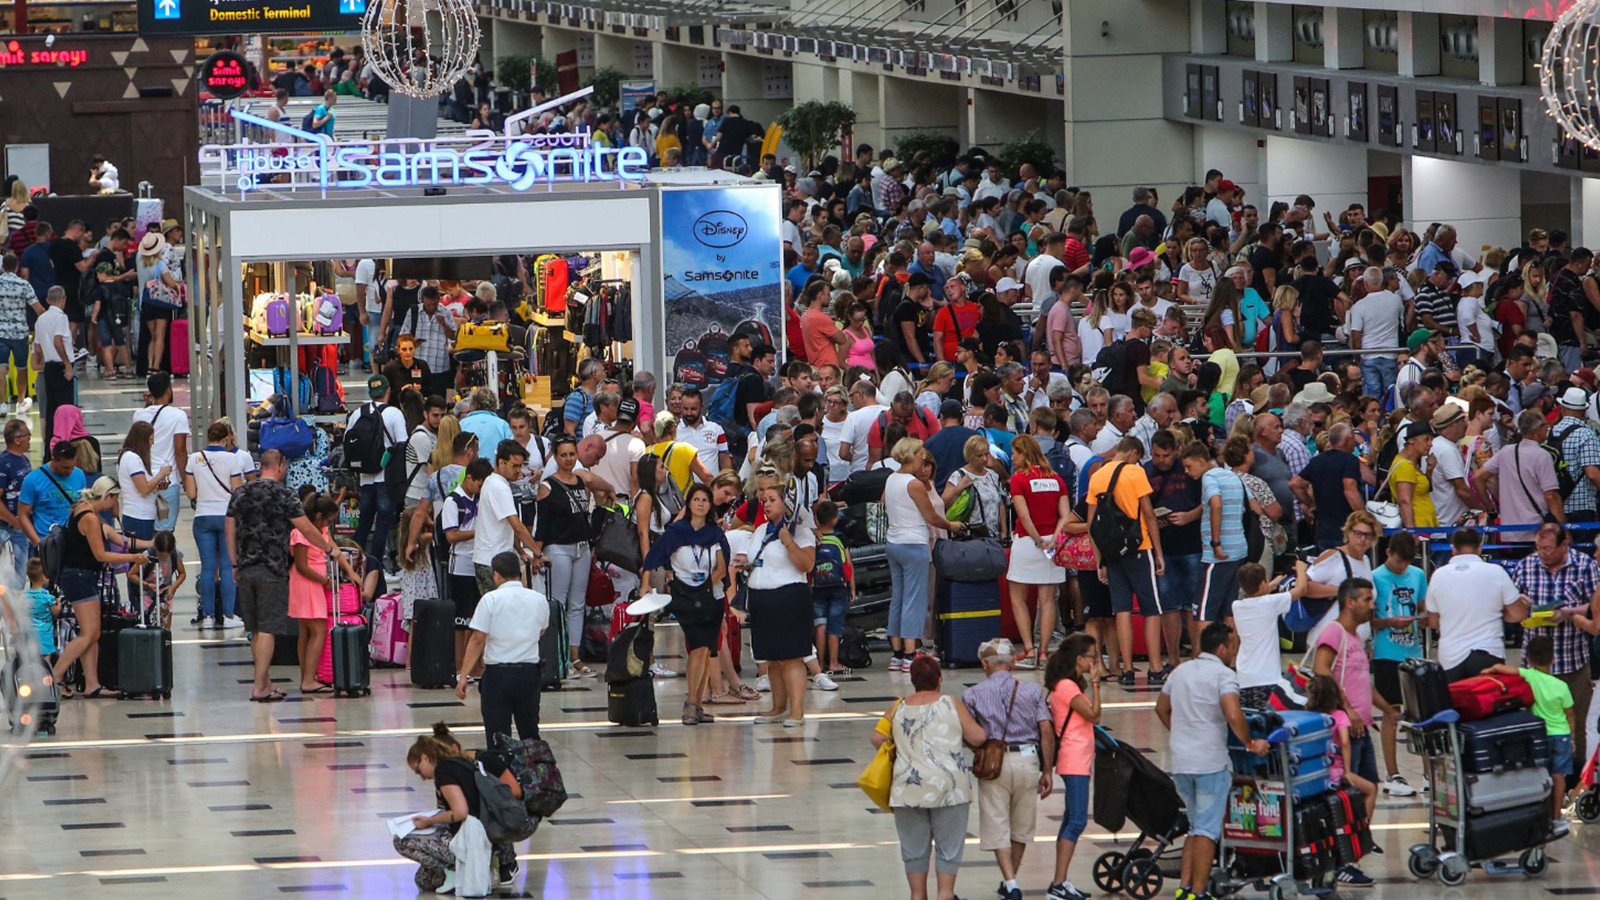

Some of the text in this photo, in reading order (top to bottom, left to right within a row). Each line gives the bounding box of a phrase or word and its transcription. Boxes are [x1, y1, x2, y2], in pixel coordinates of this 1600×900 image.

[209, 5, 310, 20] Domestic Terminal
[212, 60, 241, 76] simit
[236, 149, 311, 170] House
[336, 141, 648, 191] Samsonite
[237, 172, 260, 190] of
[698, 221, 745, 240] Disney
[716, 253, 726, 263] by
[684, 269, 759, 282] Samsonite
[340, 502, 360, 519] Have
[1230, 791, 1281, 817] Have fun!
